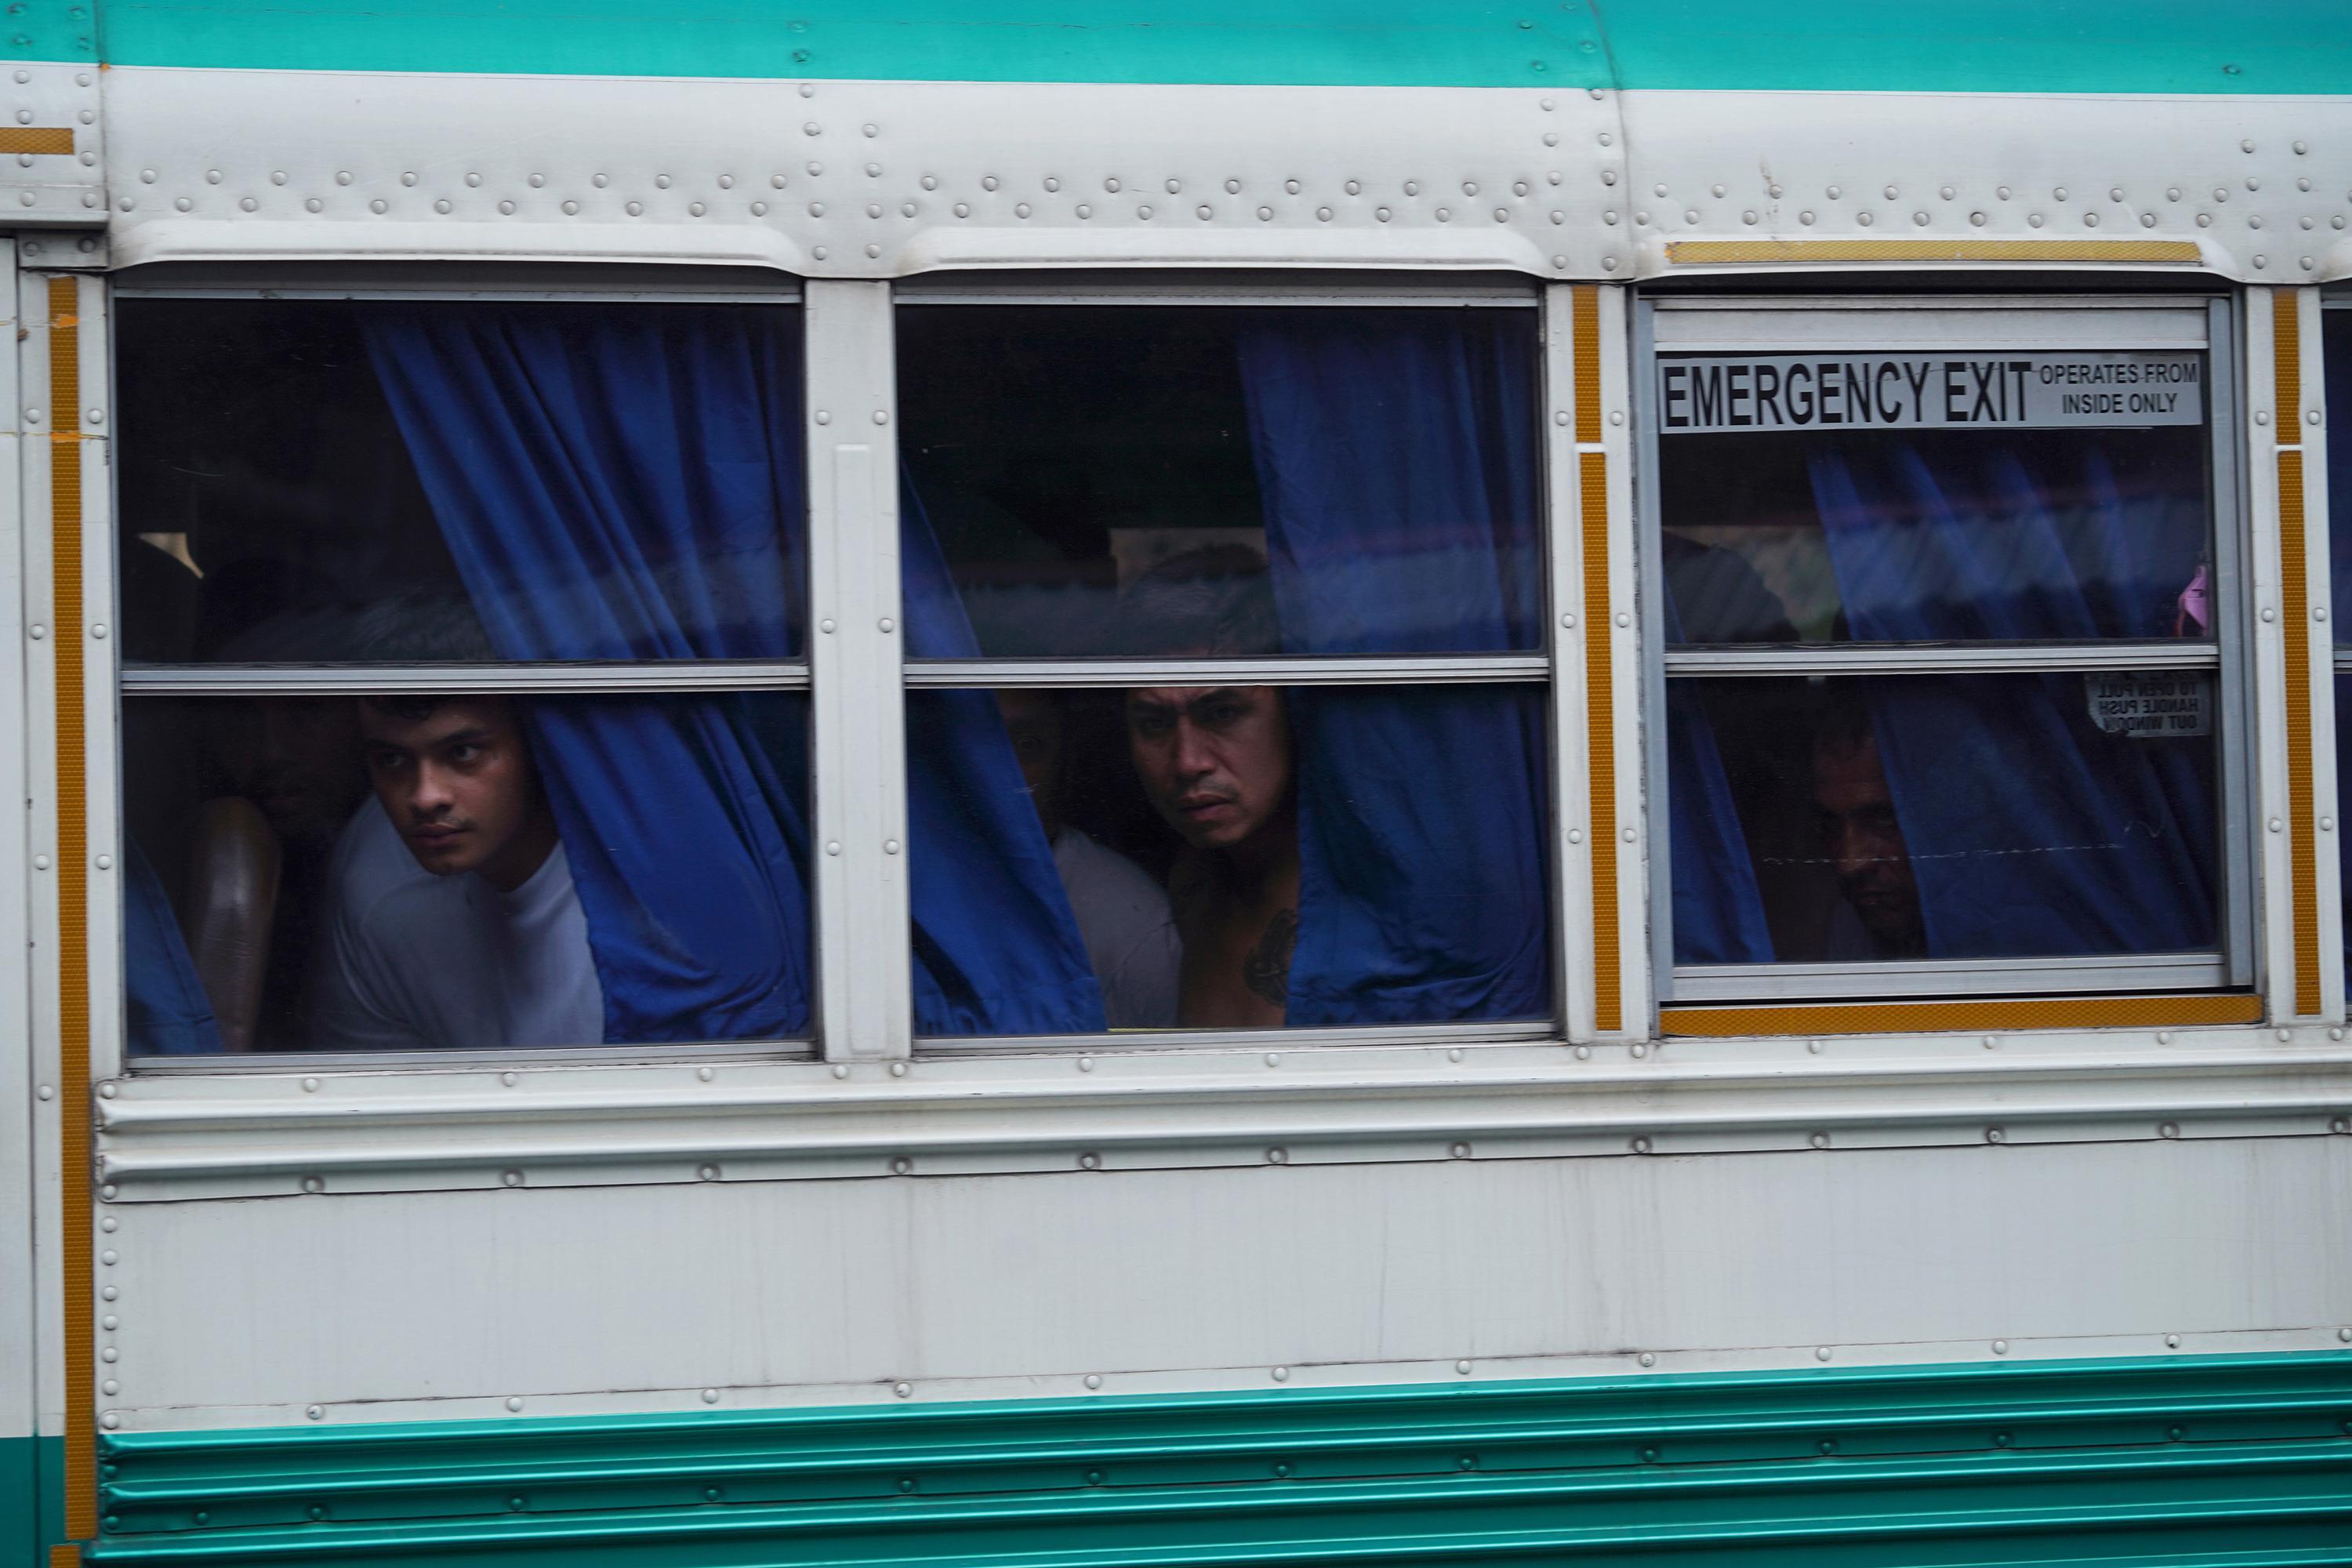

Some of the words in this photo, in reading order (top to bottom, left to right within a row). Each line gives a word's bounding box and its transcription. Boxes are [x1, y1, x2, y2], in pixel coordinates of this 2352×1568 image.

[2040, 364, 2140, 385] OPERATES
[2144, 363, 2198, 383] FROM
[1664, 361, 1930, 426] EMERGENCY
[1944, 361, 2031, 422] EXIT
[2063, 394, 2123, 414] INSIDE
[2129, 393, 2177, 413] ONLY
